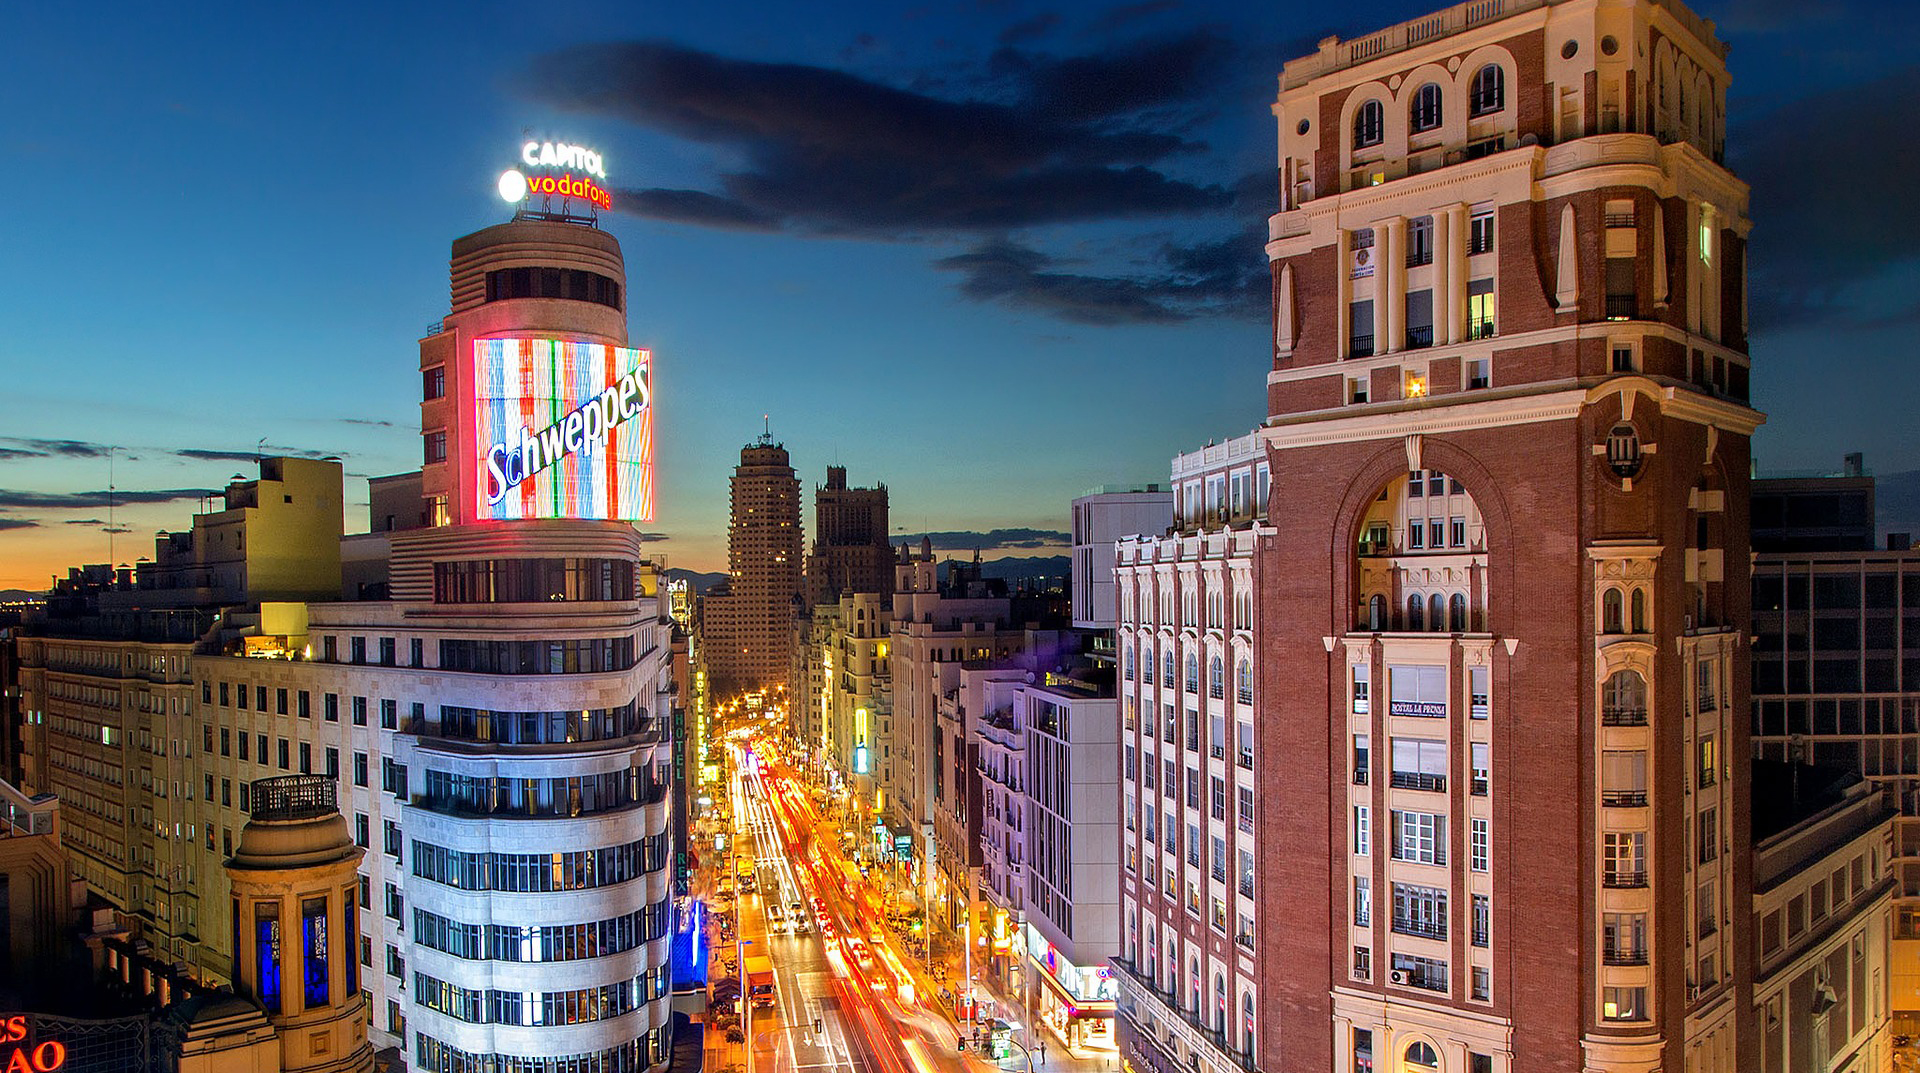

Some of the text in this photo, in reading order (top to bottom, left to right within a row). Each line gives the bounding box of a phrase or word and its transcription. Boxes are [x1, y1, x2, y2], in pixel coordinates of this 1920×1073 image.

[522, 142, 606, 178] CAPITOL
[527, 174, 611, 210] vodafone
[488, 362, 650, 506] Schweppes
[696, 671, 705, 713] HOTEL
[1414, 704, 1421, 714] LA
[675, 714, 687, 892] HOTEL REX
